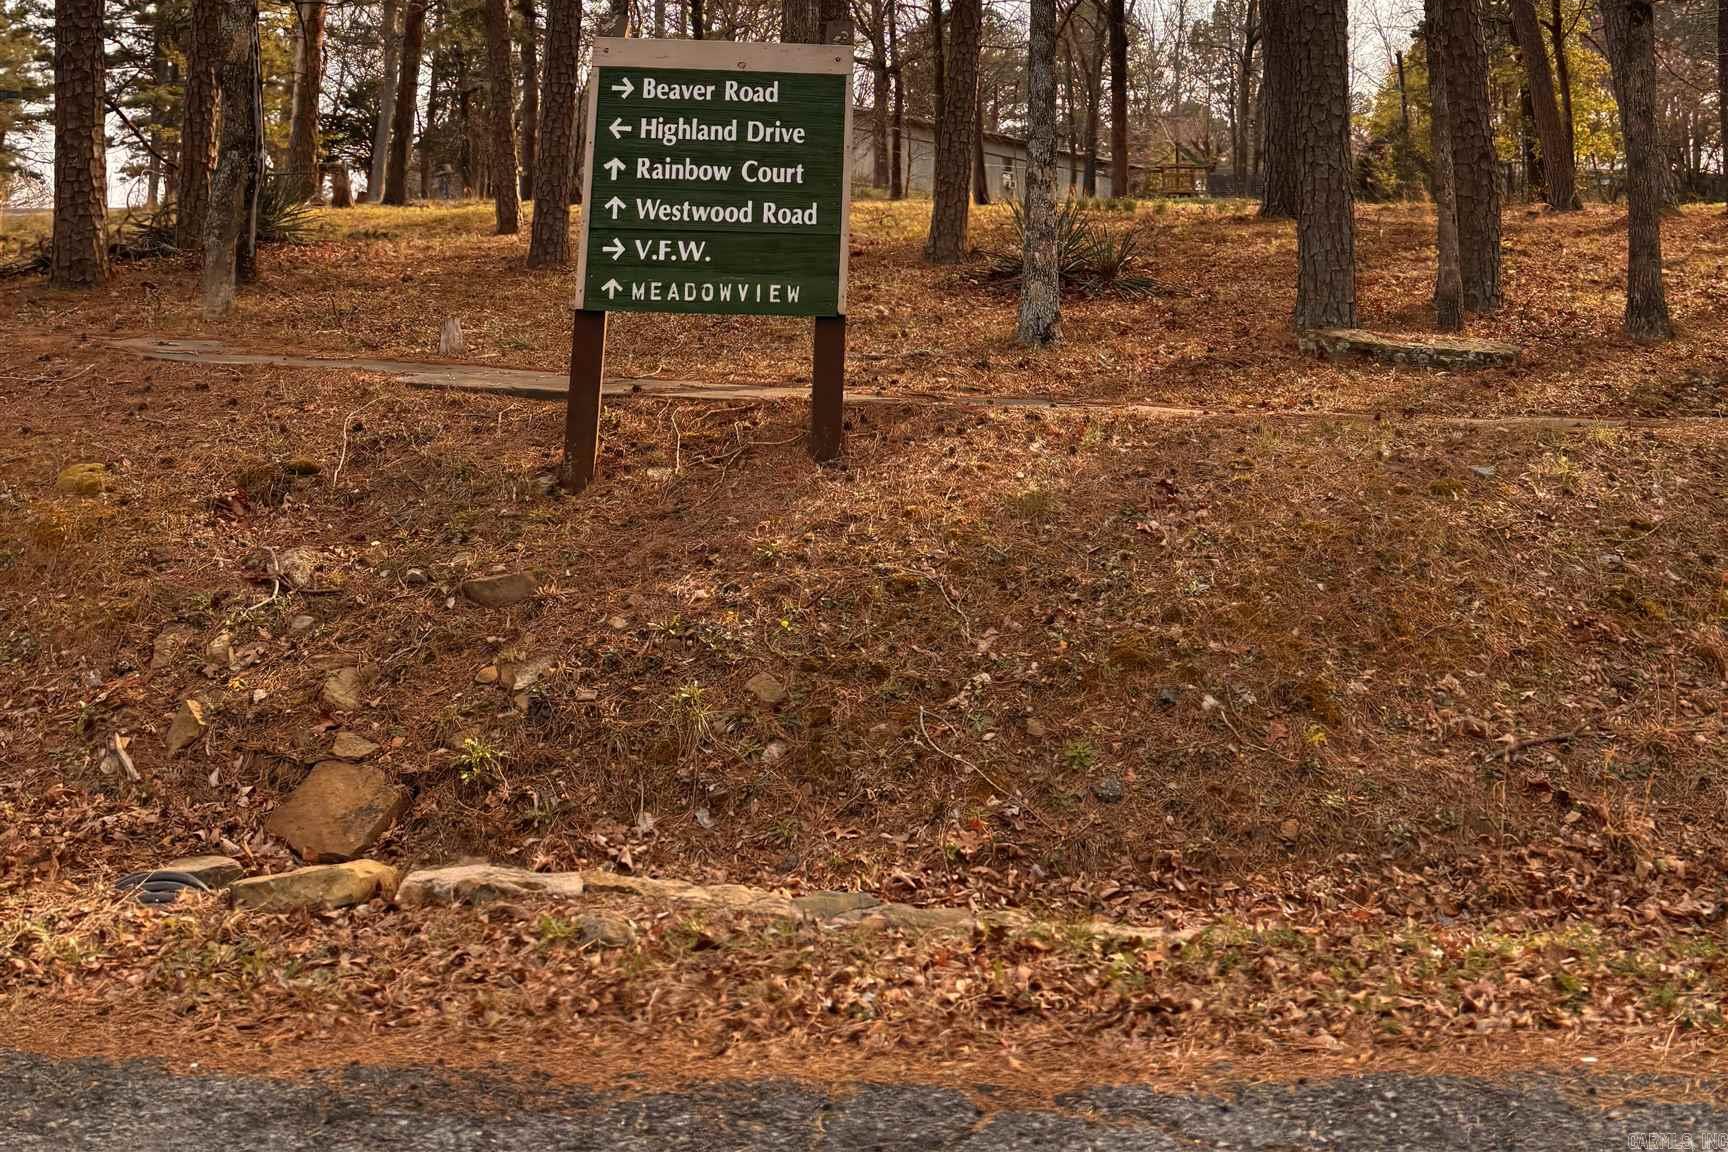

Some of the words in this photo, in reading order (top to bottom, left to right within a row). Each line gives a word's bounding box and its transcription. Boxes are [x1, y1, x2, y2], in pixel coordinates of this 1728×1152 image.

[642, 78, 715, 100] Beaver
[725, 80, 779, 102] Road
[639, 117, 737, 145] Highland
[747, 120, 805, 143] Drive
[636, 158, 732, 181] Rainbow
[741, 160, 804, 183] Court
[635, 198, 752, 223] Westwood
[762, 202, 817, 225] Road
[635, 239, 711, 262] V.F.W.
[631, 282, 800, 303] MEADOWVIEW
